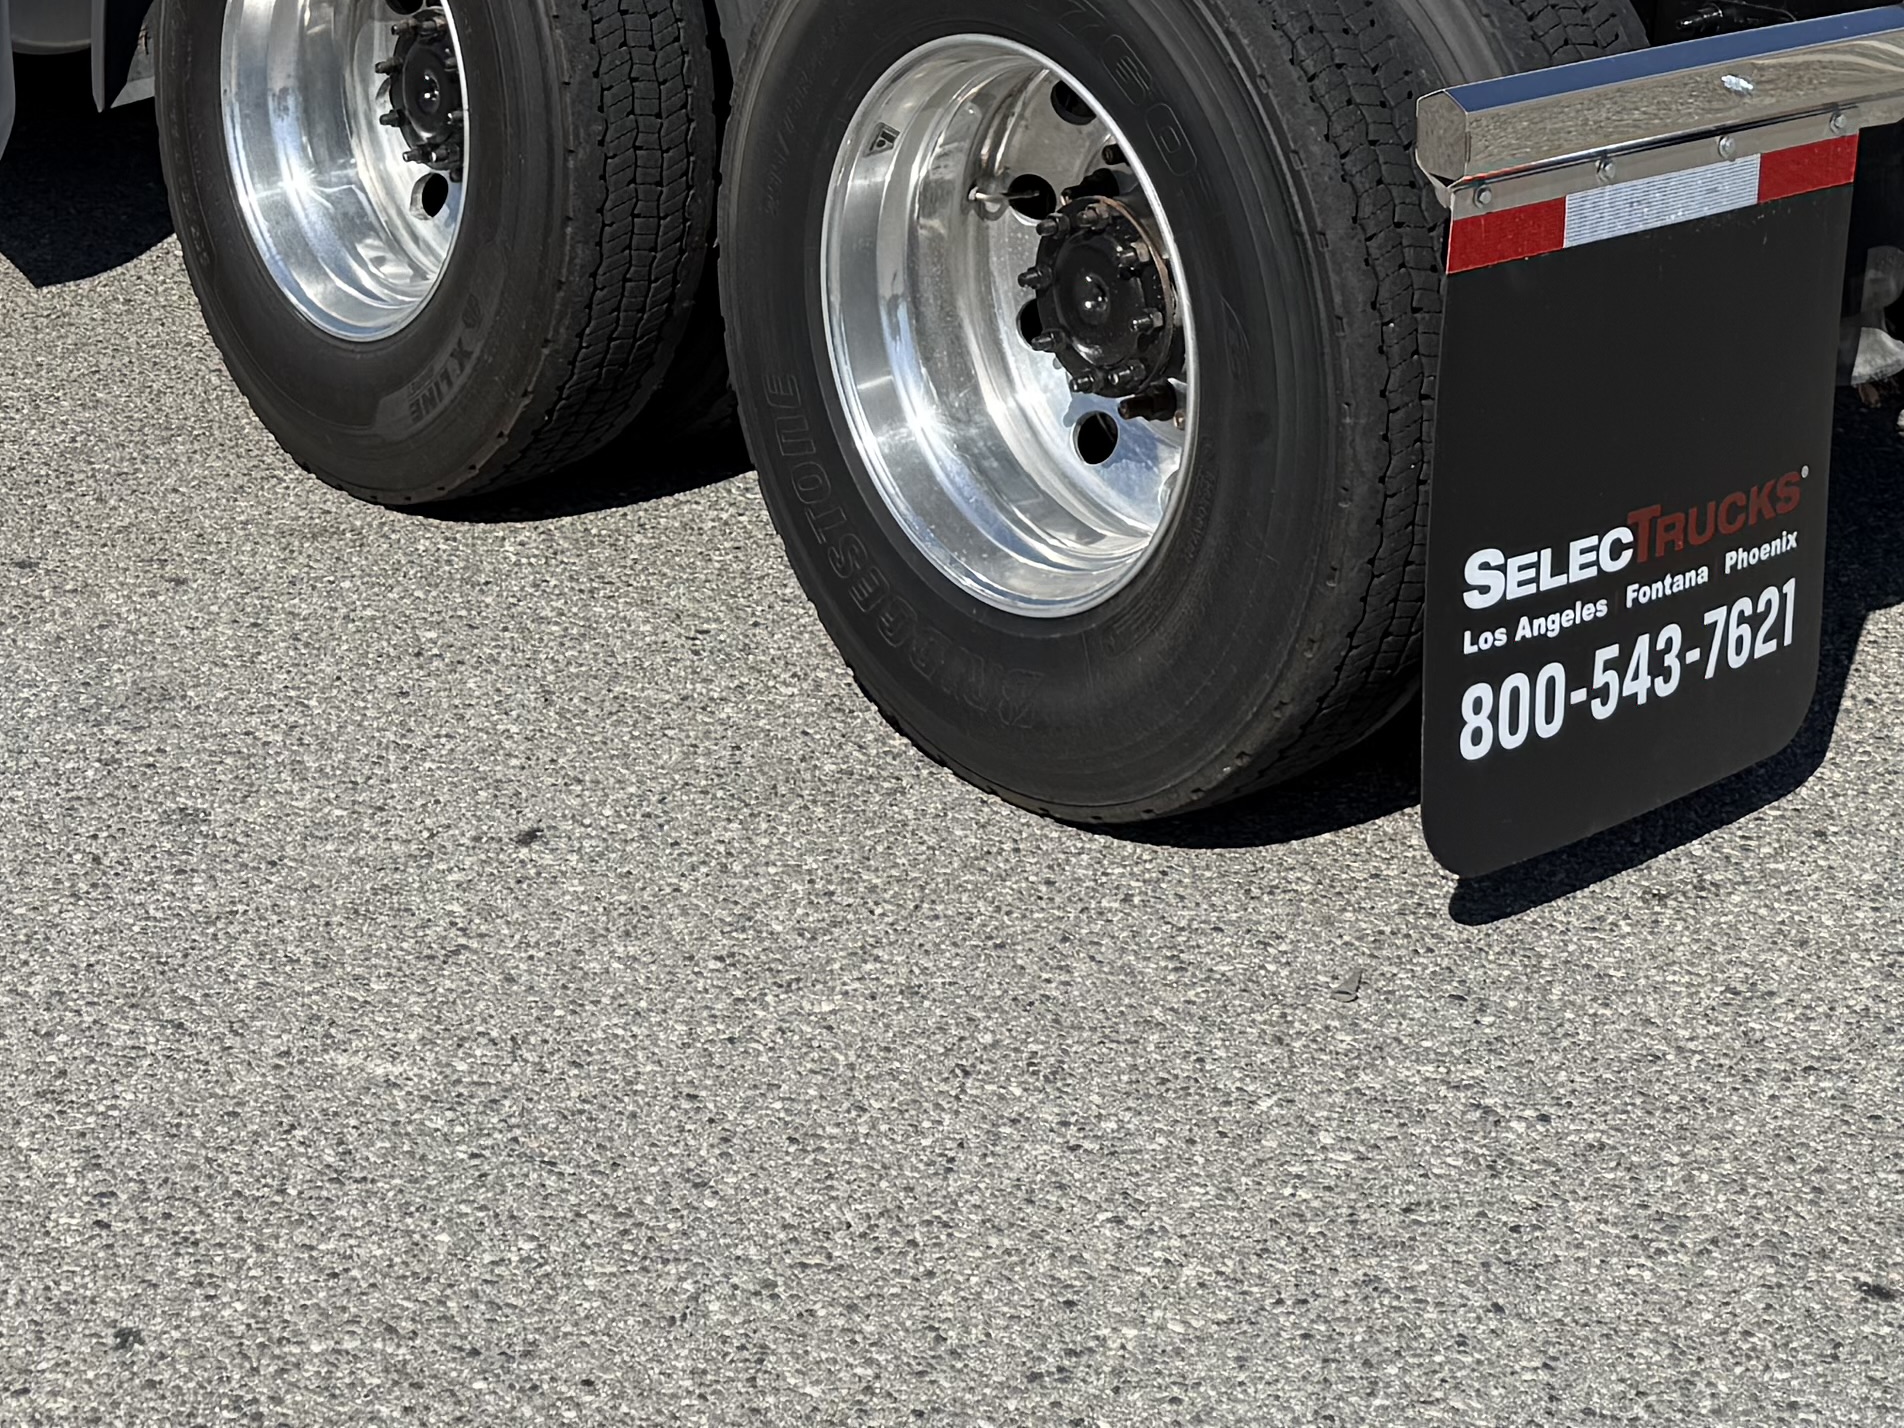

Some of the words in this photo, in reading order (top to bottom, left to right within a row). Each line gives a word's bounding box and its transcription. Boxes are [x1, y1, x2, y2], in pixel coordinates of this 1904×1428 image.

[1459, 577, 1797, 761] 800-543-7621
[1463, 625, 1508, 655] Los
[1515, 596, 1608, 642] Angeles
[1625, 565, 1709, 609] Fontana
[1724, 529, 1798, 575] Phoenix
